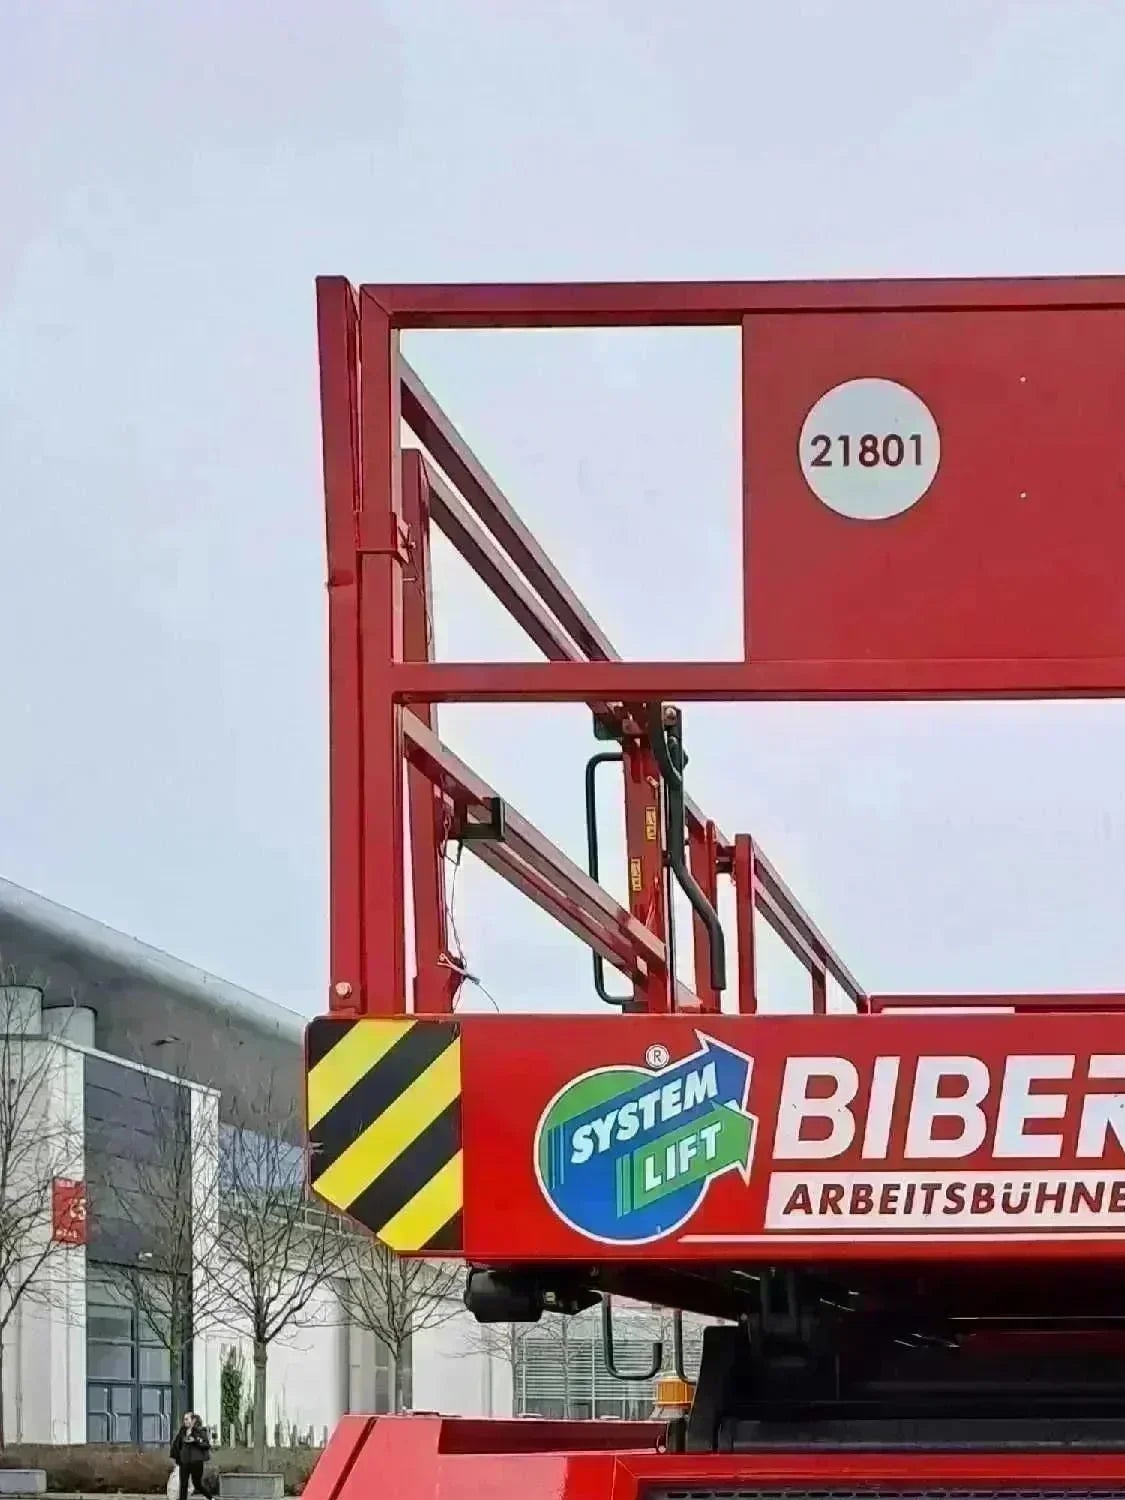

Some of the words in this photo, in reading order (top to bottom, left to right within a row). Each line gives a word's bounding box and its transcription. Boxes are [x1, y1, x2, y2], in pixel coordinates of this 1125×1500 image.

[810, 433, 923, 468] 21801
[570, 1060, 719, 1164] SYSTEM
[644, 1121, 722, 1192] LIFT
